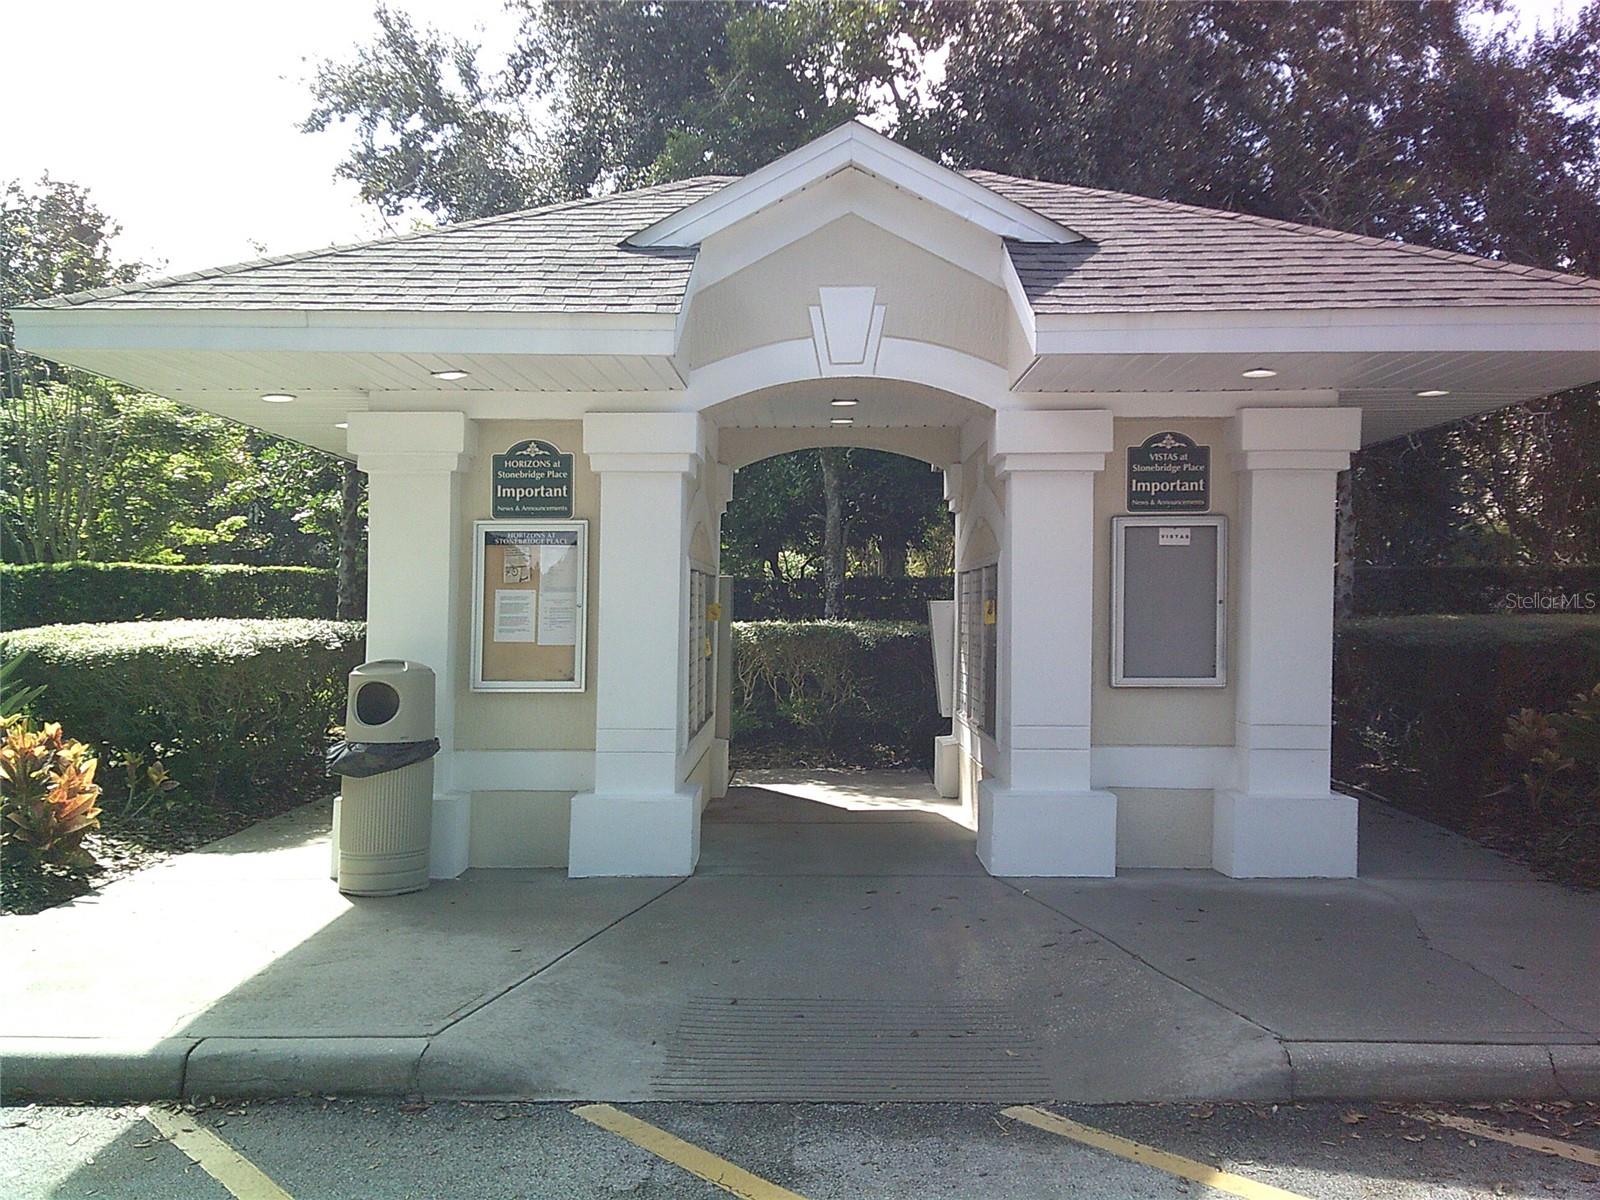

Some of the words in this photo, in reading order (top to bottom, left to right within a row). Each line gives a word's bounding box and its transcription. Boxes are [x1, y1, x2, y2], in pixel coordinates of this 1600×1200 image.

[1149, 453, 1178, 461] VISTAS
[1179, 453, 1188, 461] at
[504, 460, 551, 468] HORIZONS
[552, 460, 561, 468] at
[1132, 464, 1181, 473] Stonebridge
[1183, 463, 1205, 471] Place
[497, 470, 546, 480] Stonebridge
[547, 470, 568, 478] Place
[1131, 479, 1205, 496] Important
[497, 485, 568, 501] Important
